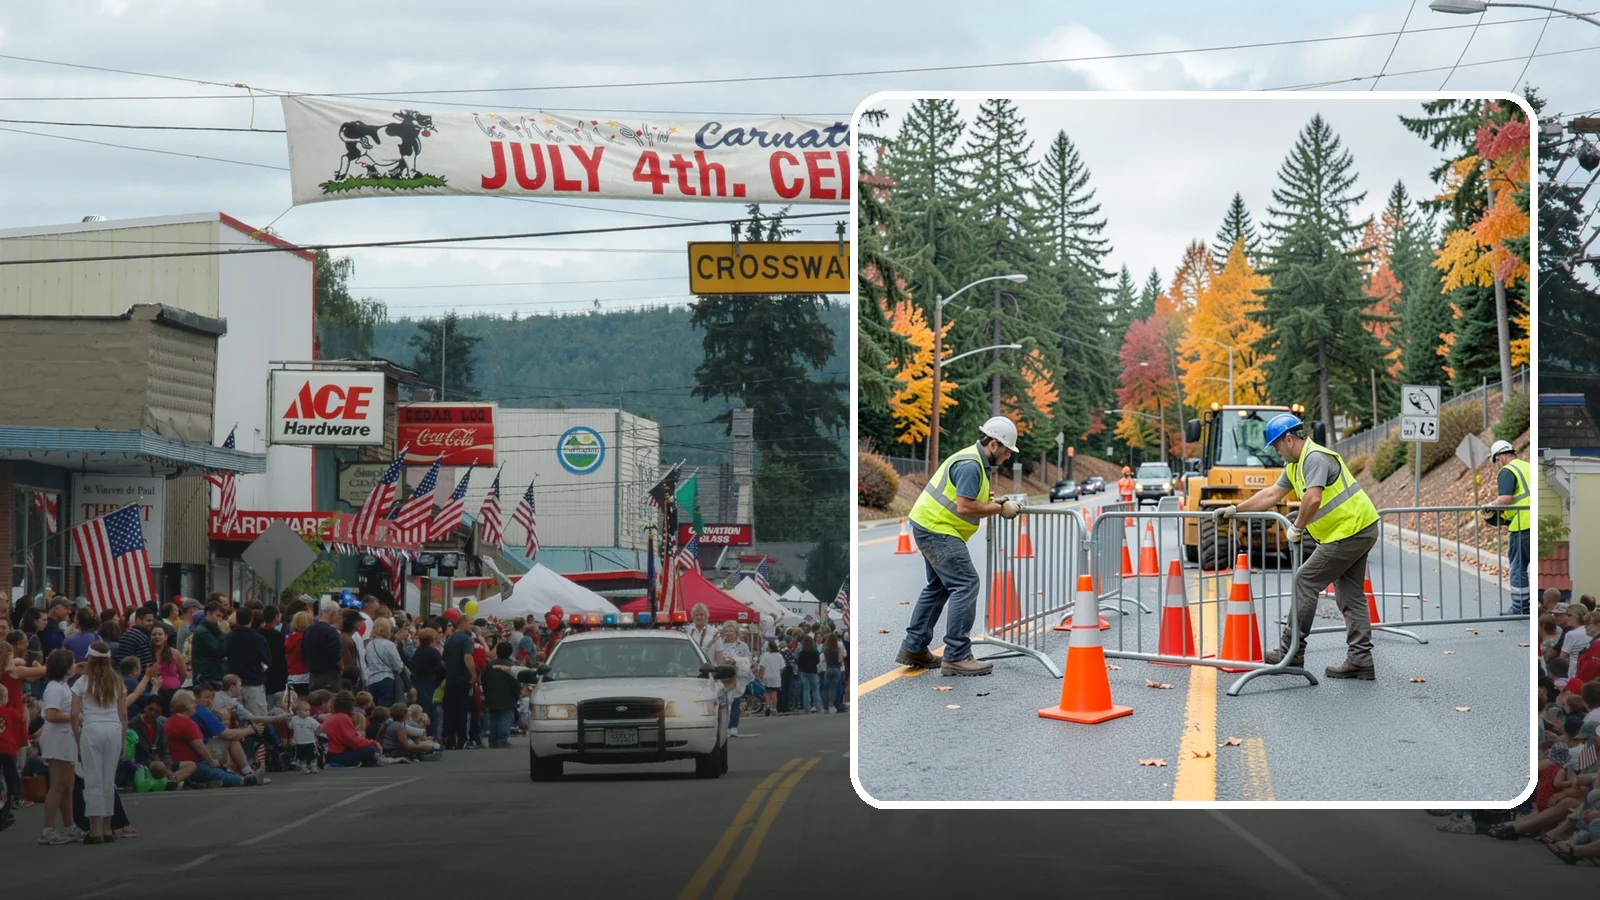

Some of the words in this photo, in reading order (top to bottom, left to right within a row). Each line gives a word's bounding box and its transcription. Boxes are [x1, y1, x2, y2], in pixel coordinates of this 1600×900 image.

[482, 141, 605, 193] JULY
[632, 150, 746, 198] 4th.
[696, 254, 850, 280] CROSSWA
[283, 380, 373, 420] ACE
[406, 409, 453, 422] CEDAR
[283, 421, 371, 437] Hardware
[416, 428, 477, 447] Coca-Cola
[83, 486, 94, 495] St.
[95, 485, 124, 495] Vincent
[126, 486, 136, 495] de
[137, 486, 155, 496] Paul
[688, 526, 741, 535] CRNATION
[699, 535, 730, 544] GLASS
